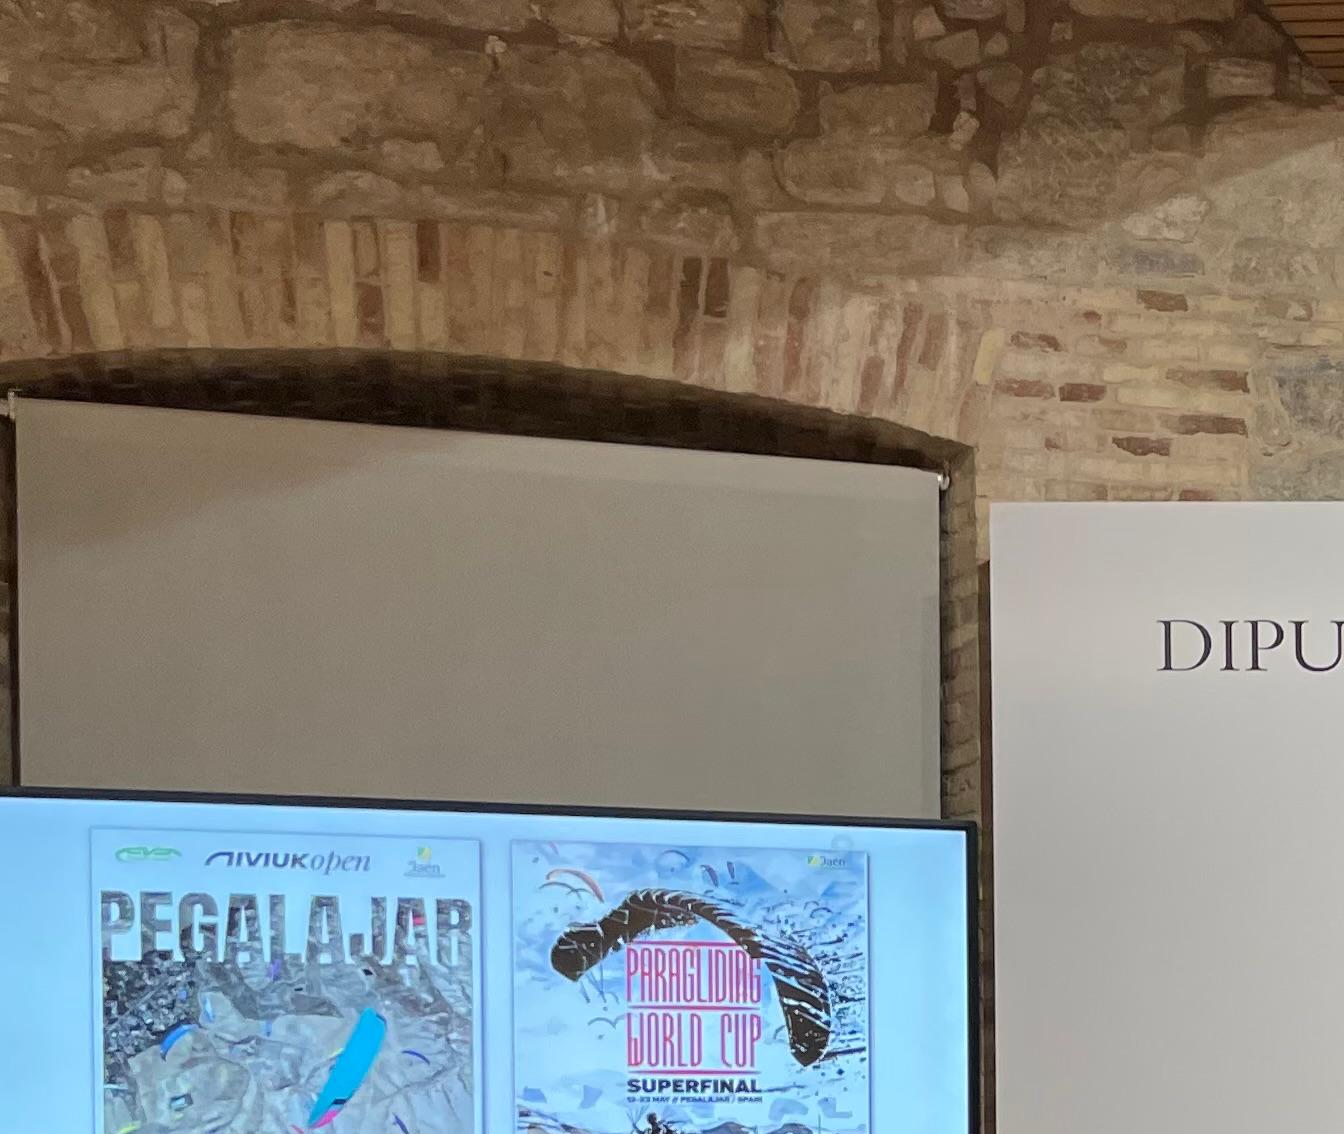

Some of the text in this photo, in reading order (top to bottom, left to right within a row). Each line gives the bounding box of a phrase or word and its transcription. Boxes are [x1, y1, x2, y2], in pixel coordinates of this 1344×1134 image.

[100, 890, 472, 966] PEGALAJAR
[626, 946, 762, 1004] PARAGLIDING
[626, 1012, 762, 1069] WORLD CUP
[627, 1078, 762, 1093] SUPERFINAL
